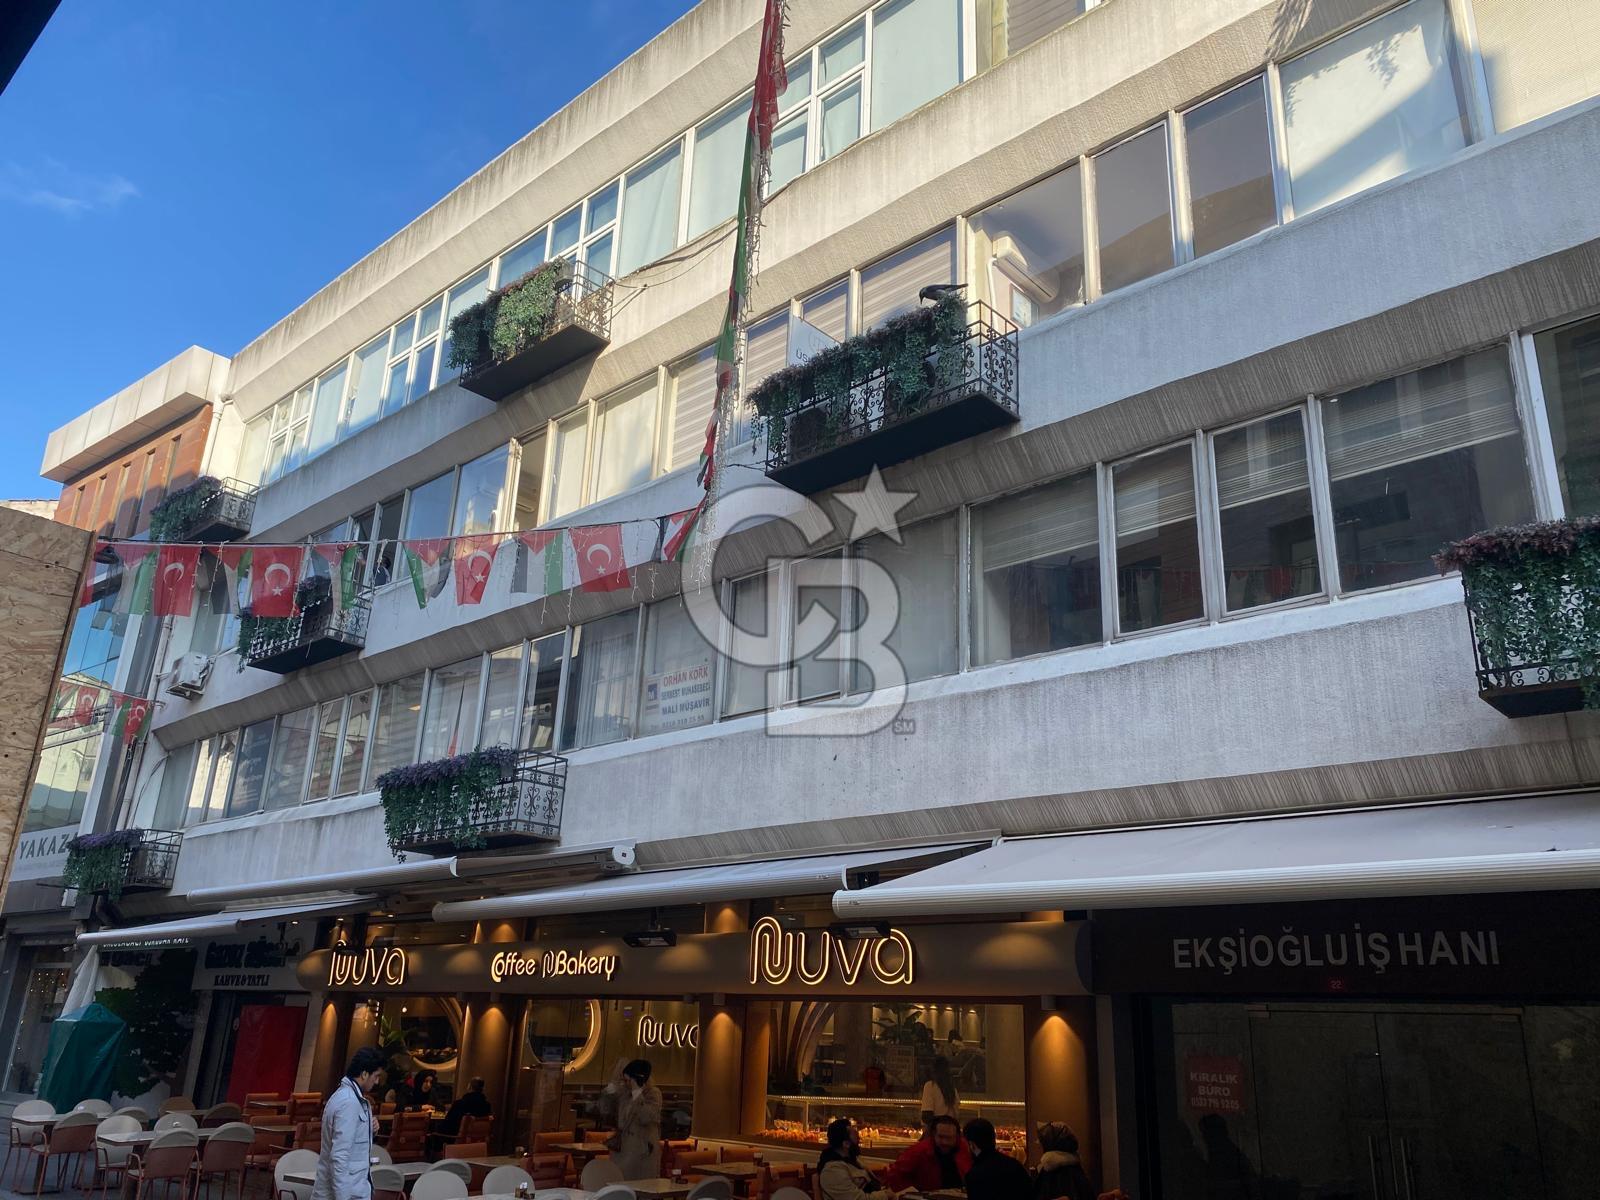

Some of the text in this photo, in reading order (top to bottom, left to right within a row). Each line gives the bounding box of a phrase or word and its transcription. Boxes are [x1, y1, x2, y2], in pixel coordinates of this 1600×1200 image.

[663, 671, 688, 688] ORHAN
[19, 832, 78, 861] YAKAZ
[1398, 929, 1500, 966] HANI
[491, 951, 536, 983] Coffee
